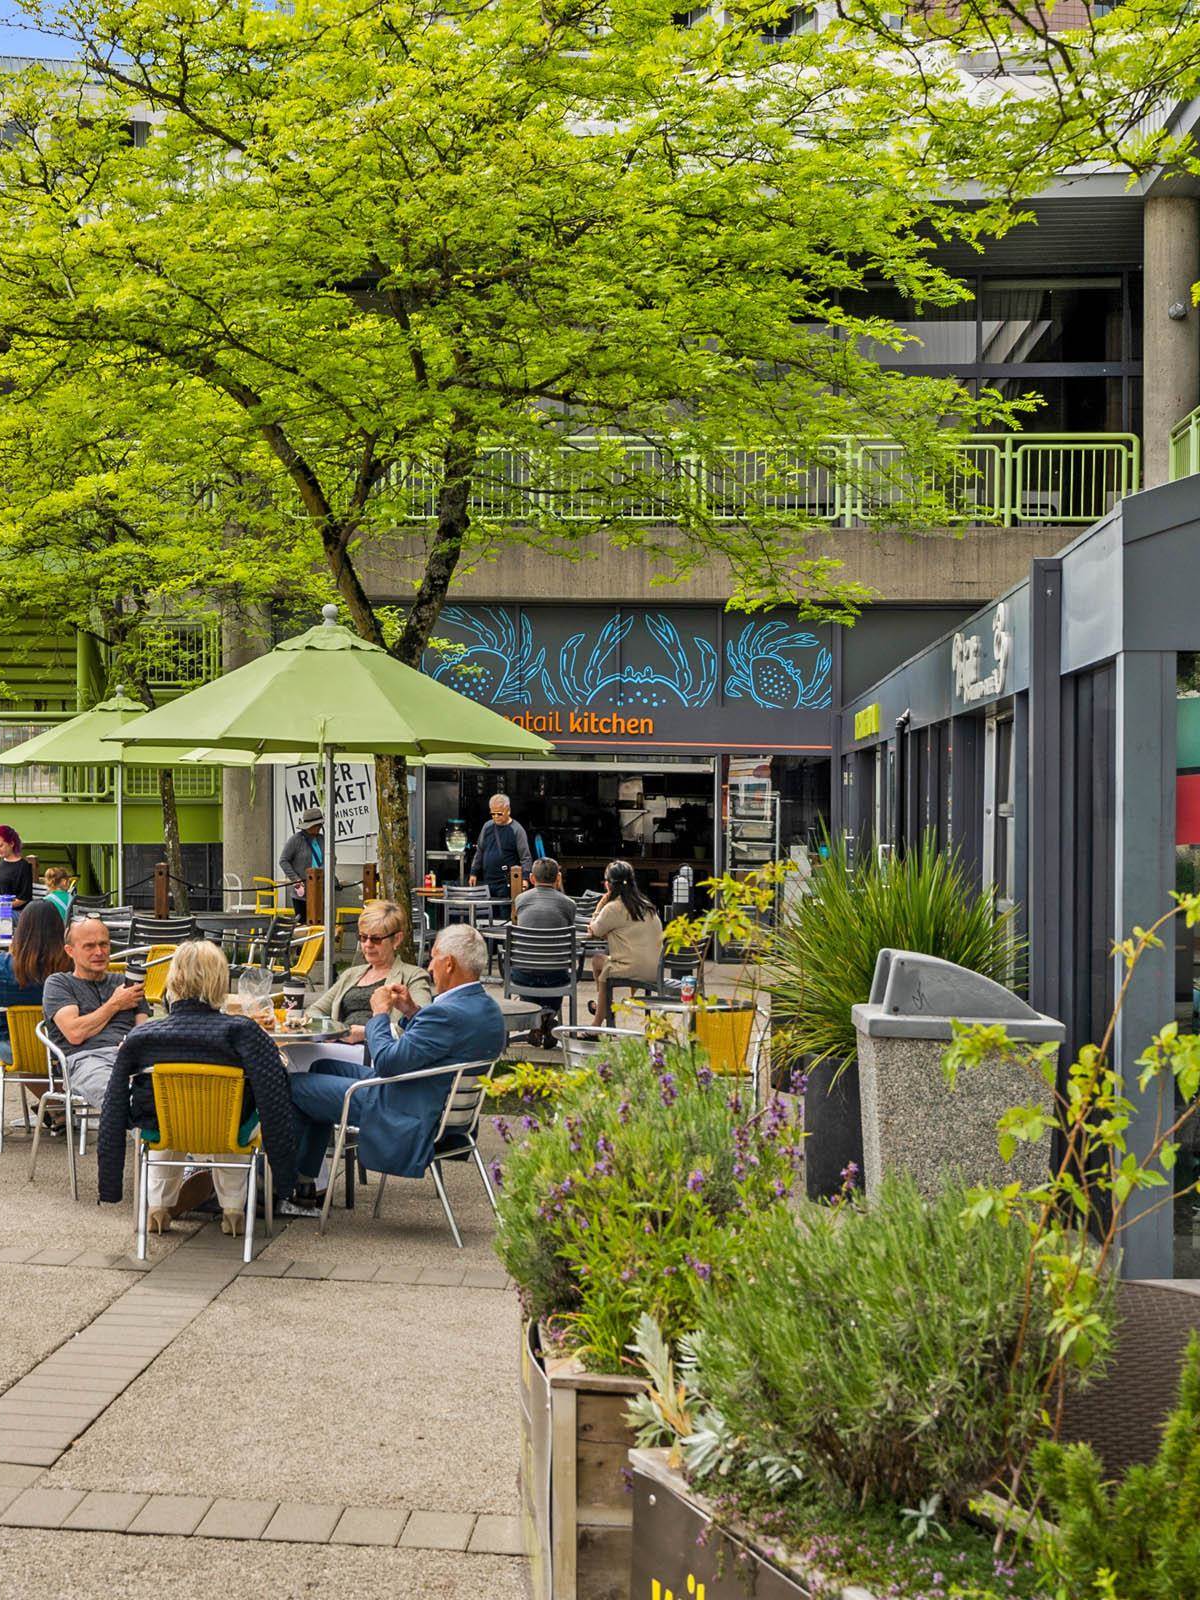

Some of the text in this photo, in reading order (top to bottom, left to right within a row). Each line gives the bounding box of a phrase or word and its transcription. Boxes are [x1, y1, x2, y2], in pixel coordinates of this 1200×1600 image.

[504, 711, 654, 735] tail kitchen
[297, 763, 353, 789] RIR
[291, 781, 366, 813] MAKET
[321, 819, 354, 837] AY
